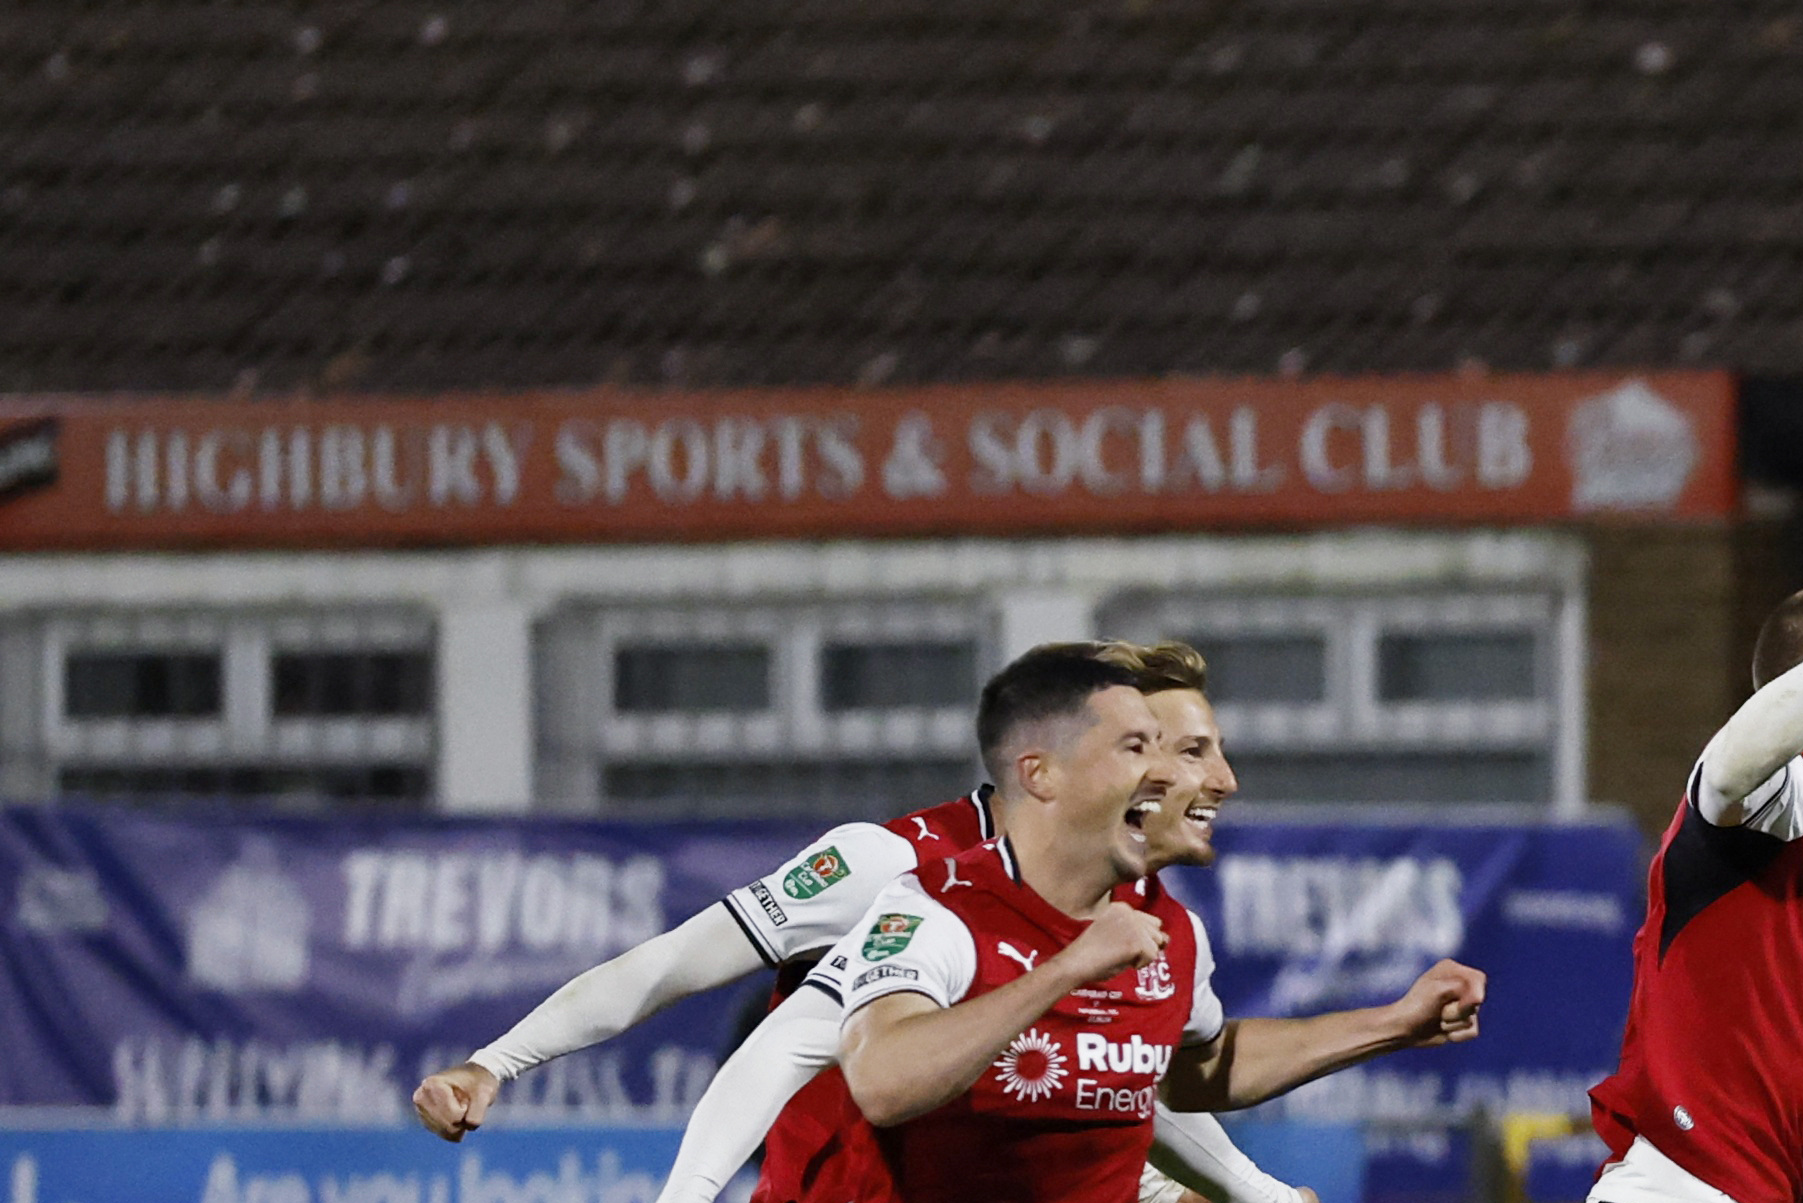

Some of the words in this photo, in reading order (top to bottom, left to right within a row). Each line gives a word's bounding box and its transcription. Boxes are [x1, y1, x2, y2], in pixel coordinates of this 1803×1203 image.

[102, 420, 534, 515] HIGHBURY
[554, 411, 865, 505] SPORTS
[880, 410, 948, 499] &
[967, 404, 1287, 498] SOCIAL
[1299, 400, 1531, 493] CLUB
[345, 848, 666, 950] TREVORS
[1076, 1032, 1172, 1083] Ruby
[1075, 1078, 1160, 1119] Energ
